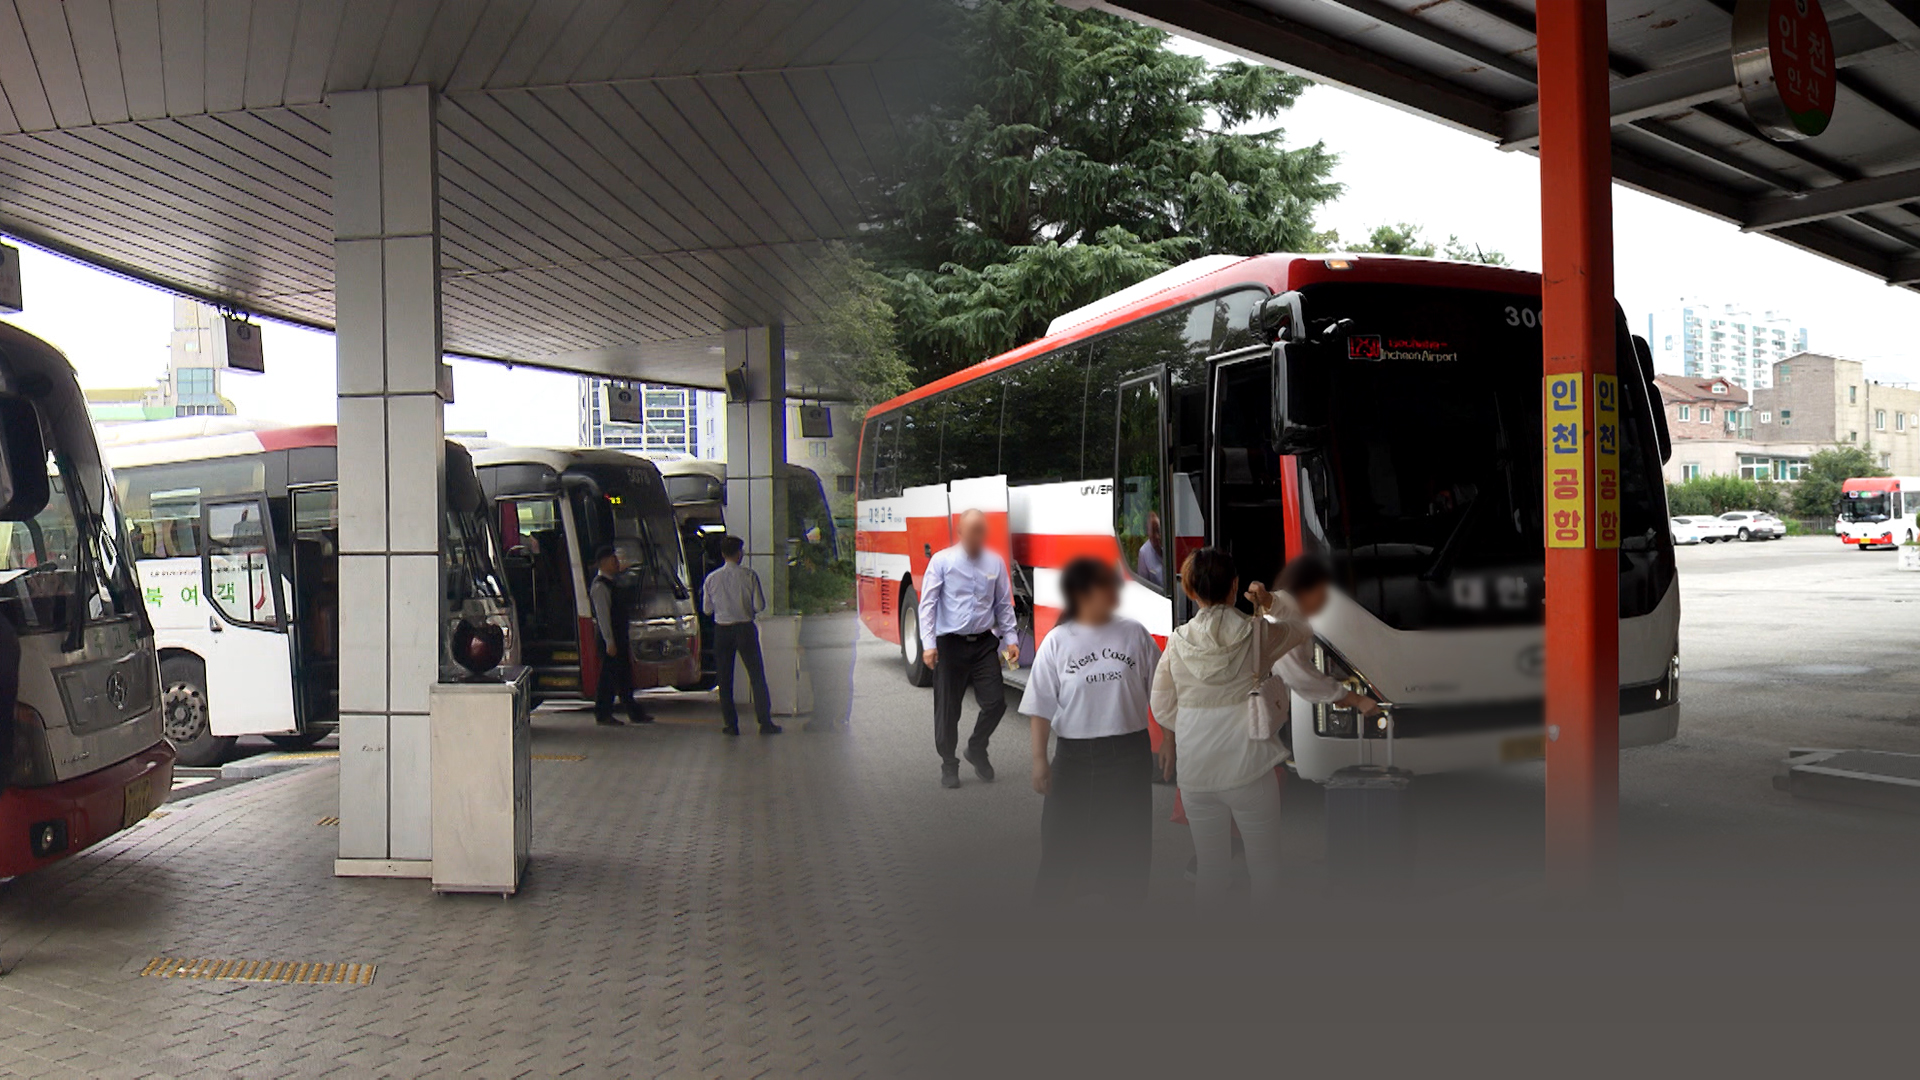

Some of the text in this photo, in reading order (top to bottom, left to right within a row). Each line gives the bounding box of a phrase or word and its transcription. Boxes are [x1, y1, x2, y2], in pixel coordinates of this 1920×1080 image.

[1778, 13, 1828, 78] 인천
[1787, 67, 1820, 107] 안산
[1504, 305, 1543, 328] 30
[1381, 347, 1458, 363] Incheon Airport
[1551, 378, 1582, 542] 인천공항
[1598, 380, 1619, 543] 인천공항
[1065, 647, 1137, 675] West Coast
